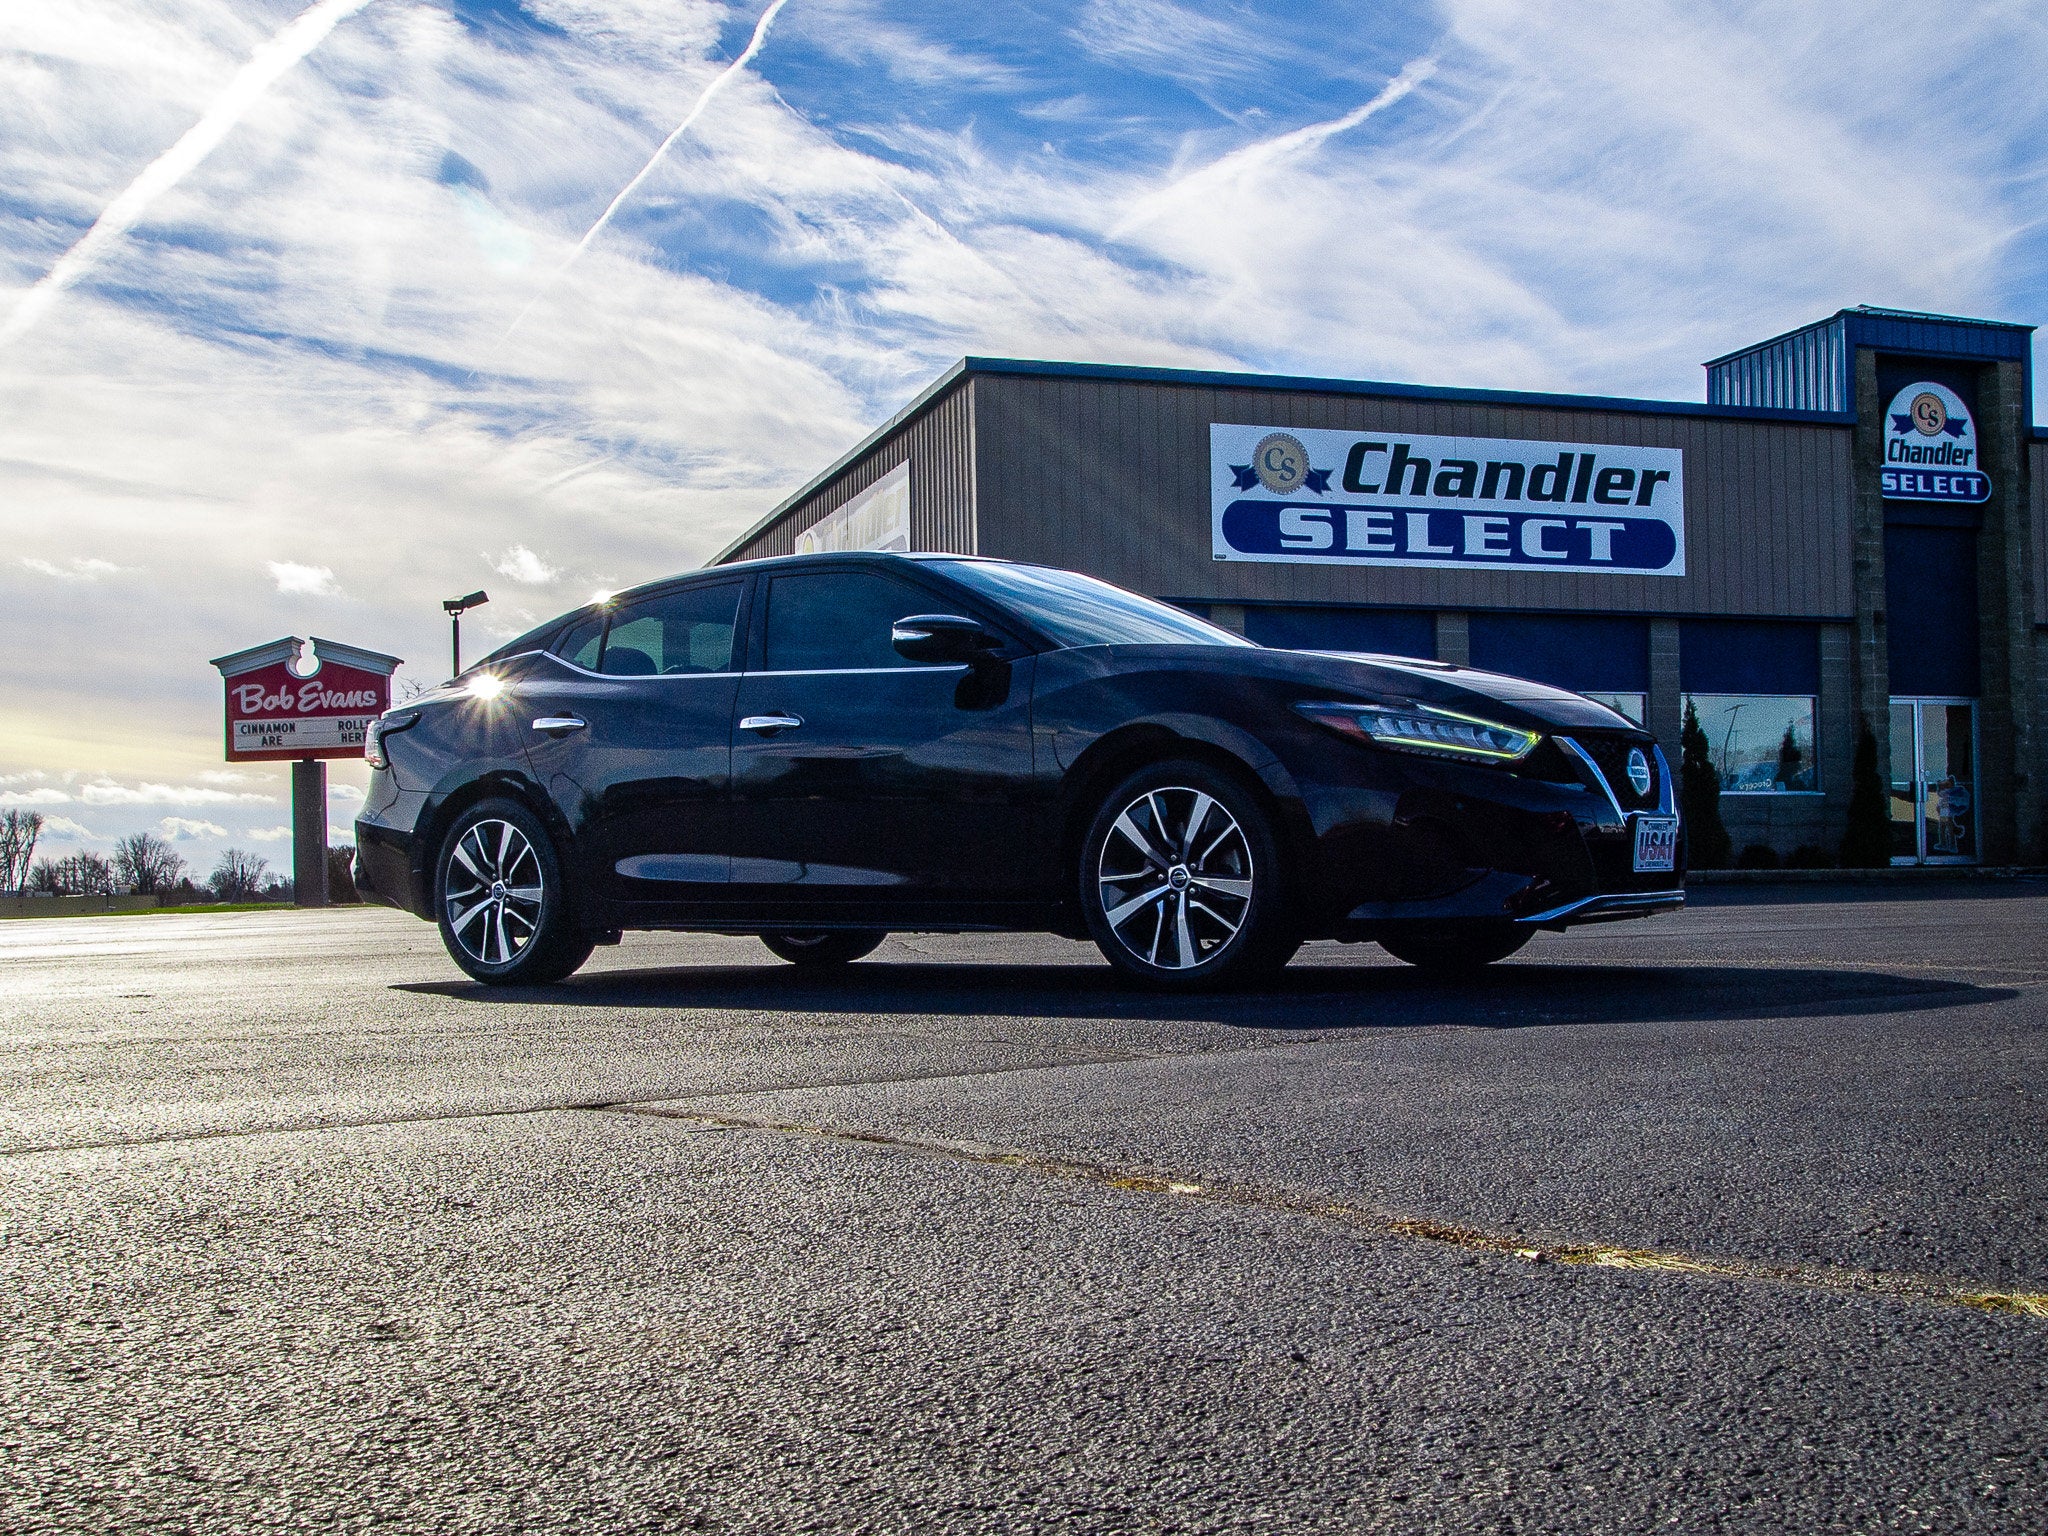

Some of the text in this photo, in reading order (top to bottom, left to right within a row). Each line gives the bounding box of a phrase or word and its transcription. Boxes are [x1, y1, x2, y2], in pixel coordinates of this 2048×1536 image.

[1918, 402, 1939, 428] CS
[1264, 447, 1297, 482] CS
[1888, 438, 1975, 467] Chandler
[1341, 440, 1671, 506] Chandler
[1881, 473, 1981, 495] SELECT
[1278, 507, 1626, 561] SELECT
[232, 681, 378, 714] Bob Evans
[240, 722, 296, 735] CINNAMON
[261, 735, 283, 746] ARE
